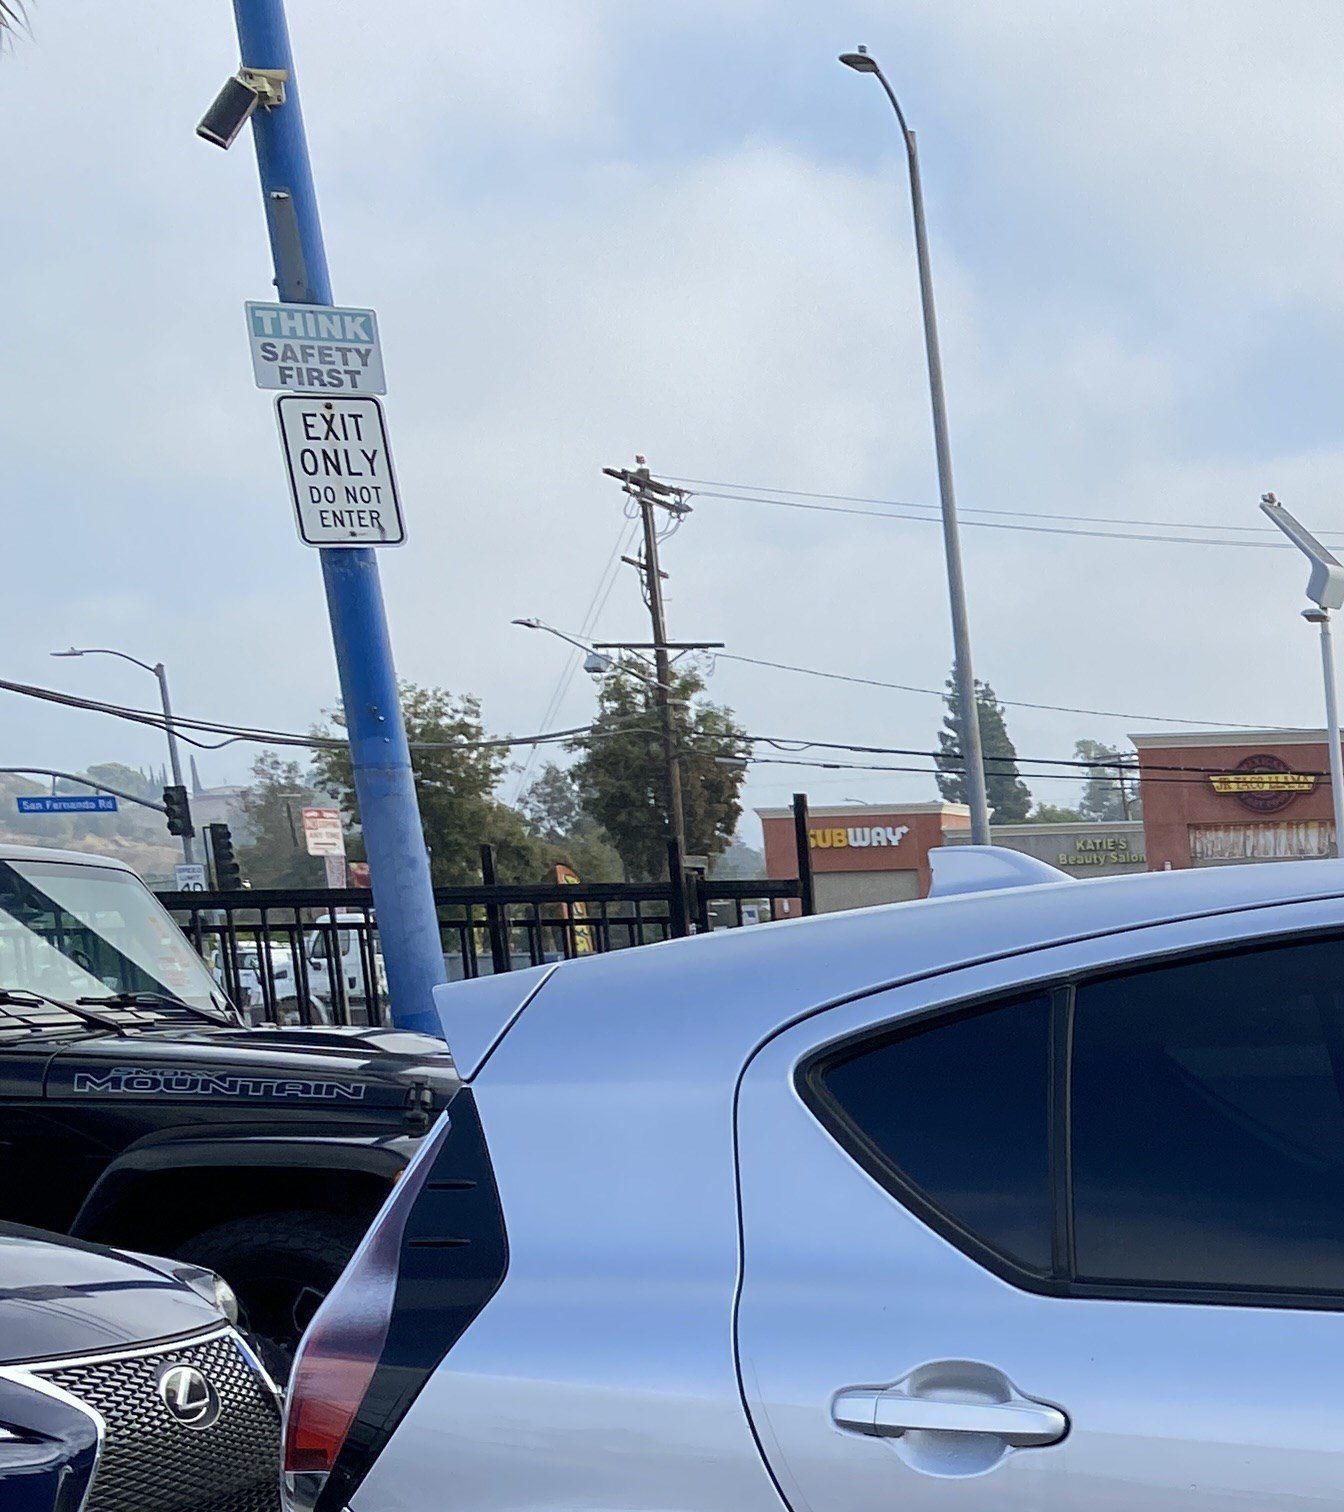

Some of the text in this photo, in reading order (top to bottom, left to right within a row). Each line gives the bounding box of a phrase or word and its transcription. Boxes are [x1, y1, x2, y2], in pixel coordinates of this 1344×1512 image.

[254, 309, 369, 341] THINK
[259, 341, 372, 367] SAFETY
[278, 365, 362, 389] FIRST
[301, 412, 363, 442] EXIT
[300, 448, 378, 477] ONLY
[308, 486, 382, 504] DO NOT
[319, 509, 382, 529] ENTER
[22, 799, 114, 811] San Fernando Rd
[1075, 838, 1128, 851] KATIE'S
[1058, 851, 1146, 866] Beauty Salon
[73, 1072, 367, 1099] MOUNTAIN
